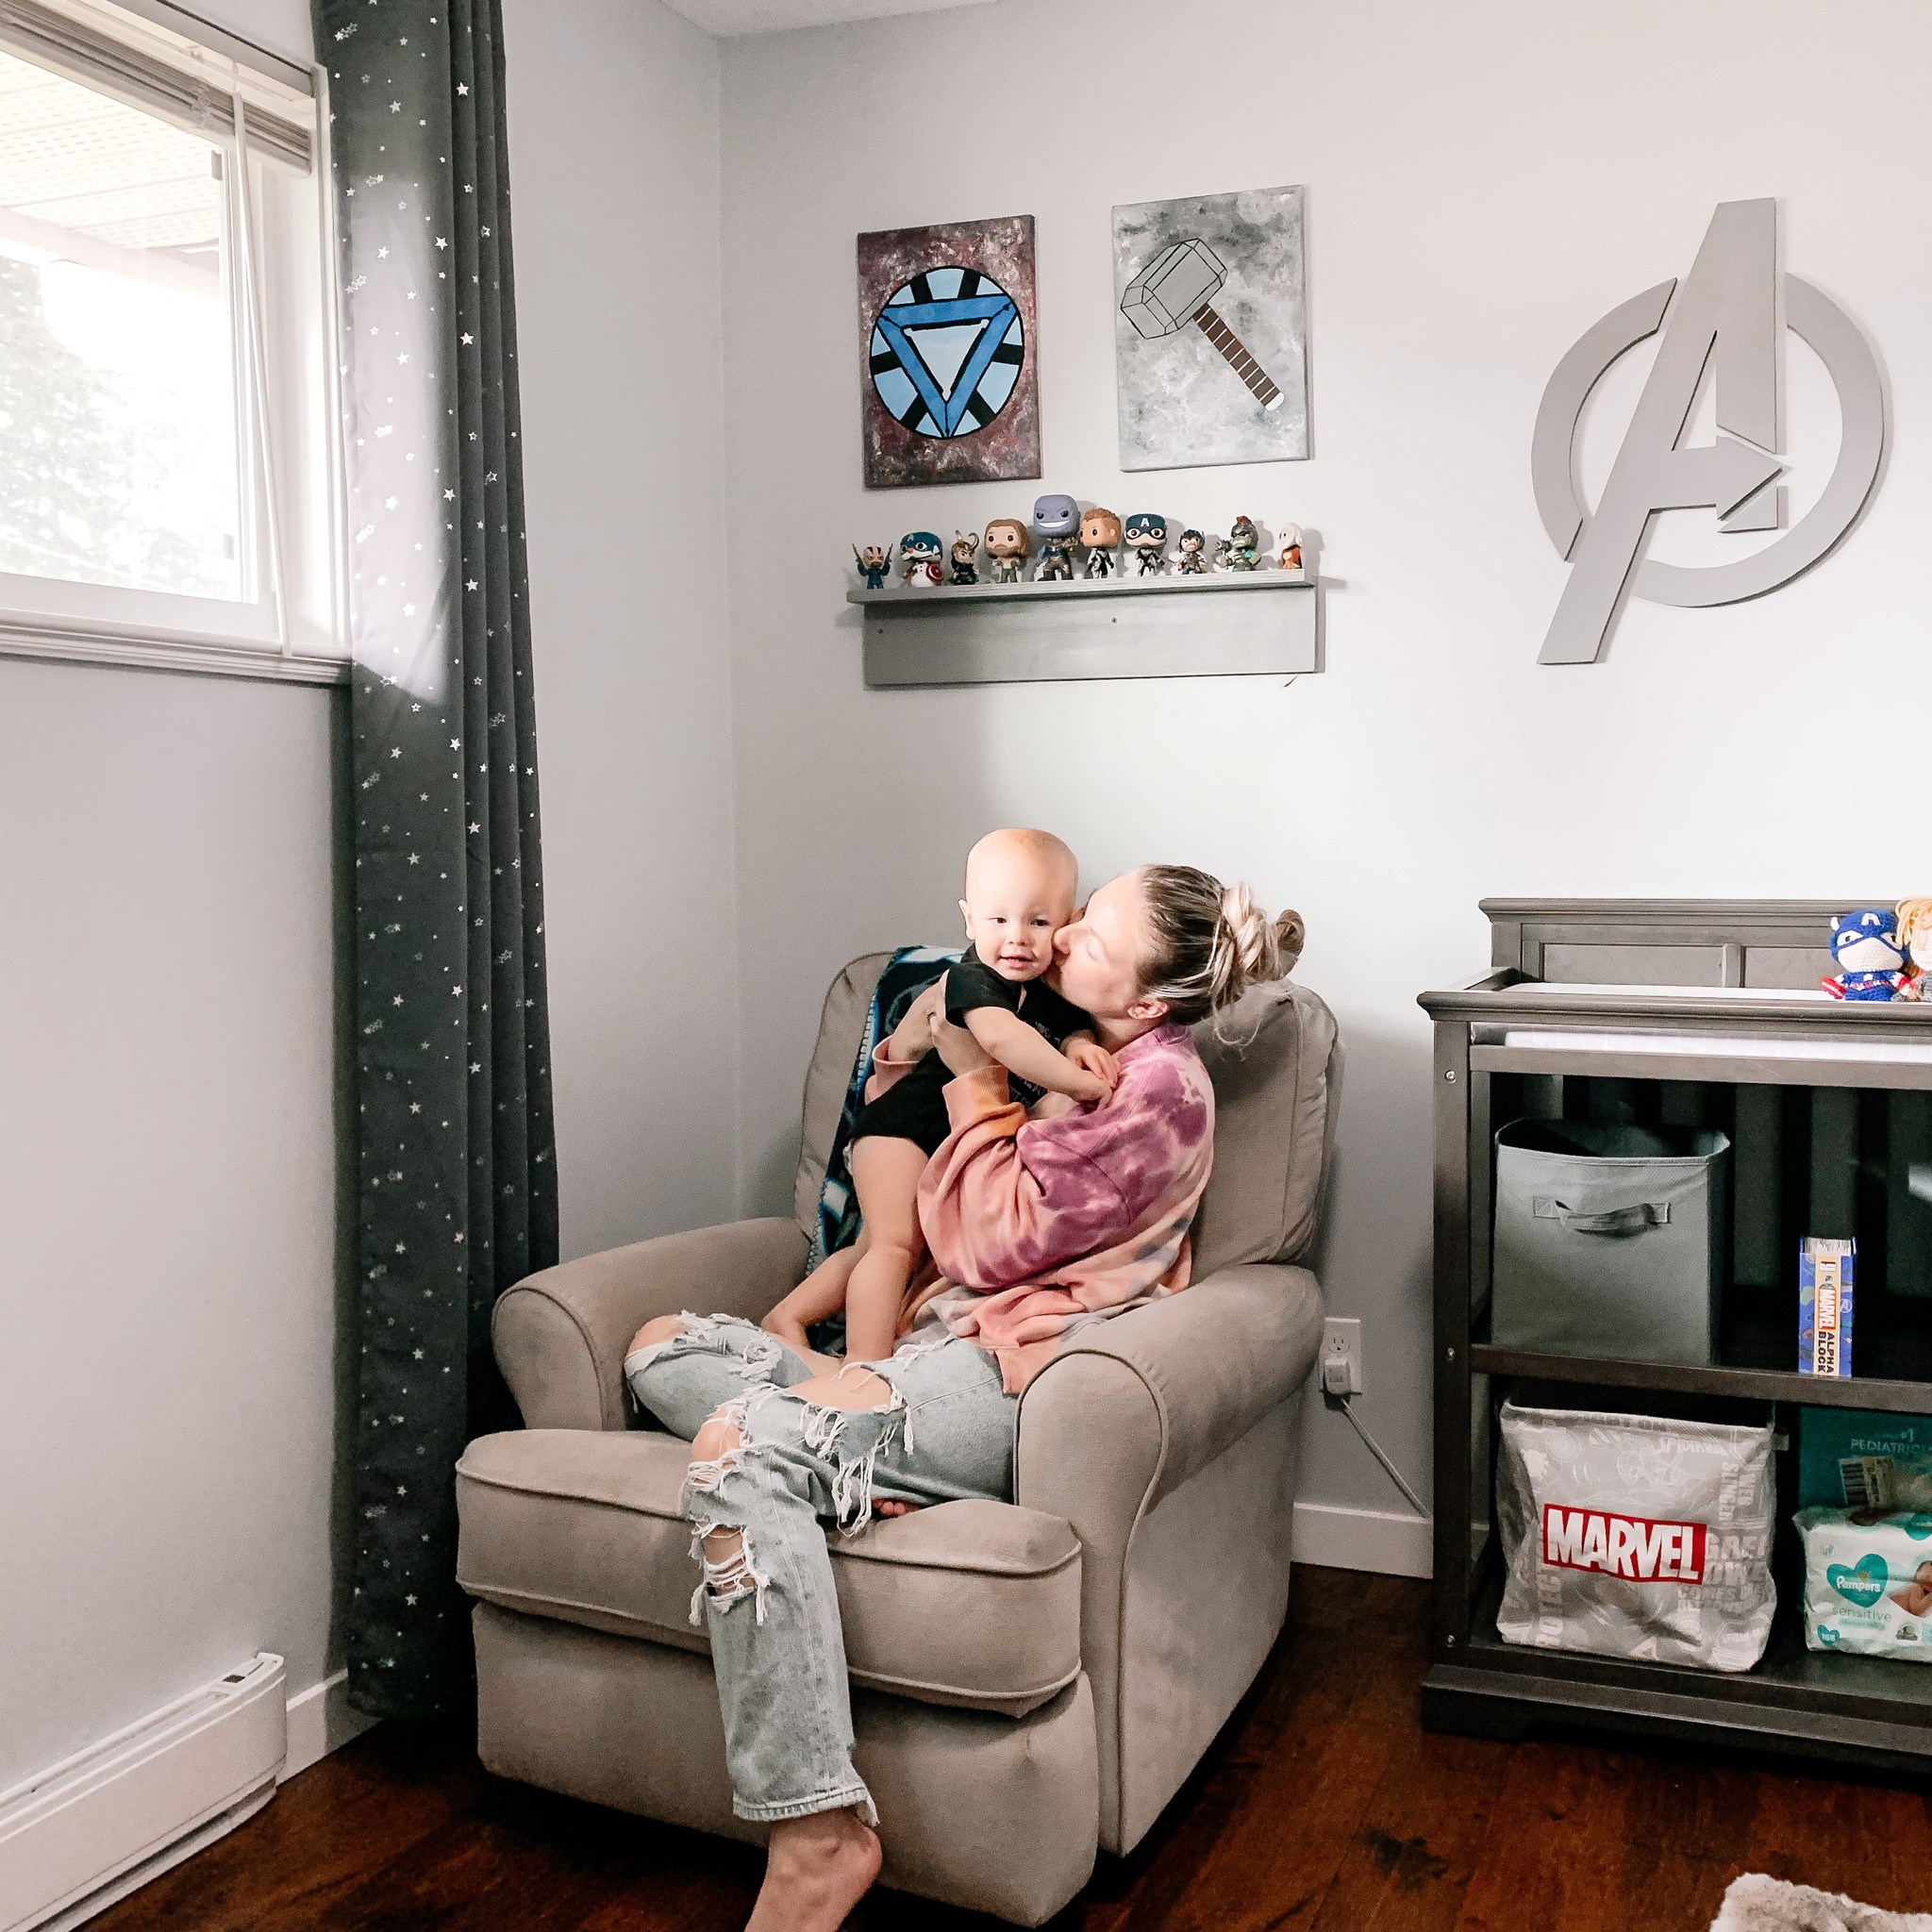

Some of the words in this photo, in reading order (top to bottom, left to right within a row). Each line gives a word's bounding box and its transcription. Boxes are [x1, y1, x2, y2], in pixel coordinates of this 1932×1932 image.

[1537, 197, 1783, 664] A
[1140, 517, 1150, 527] A
[1819, 1288, 1836, 1329] MARVEL
[1817, 1330, 1826, 1373] BLOCK
[1825, 1331, 1835, 1374] ALPHA
[1545, 1507, 1699, 1580] MARVEL
[1836, 1574, 1881, 1593] Pampers
[1832, 1606, 1892, 1622] sensitive
